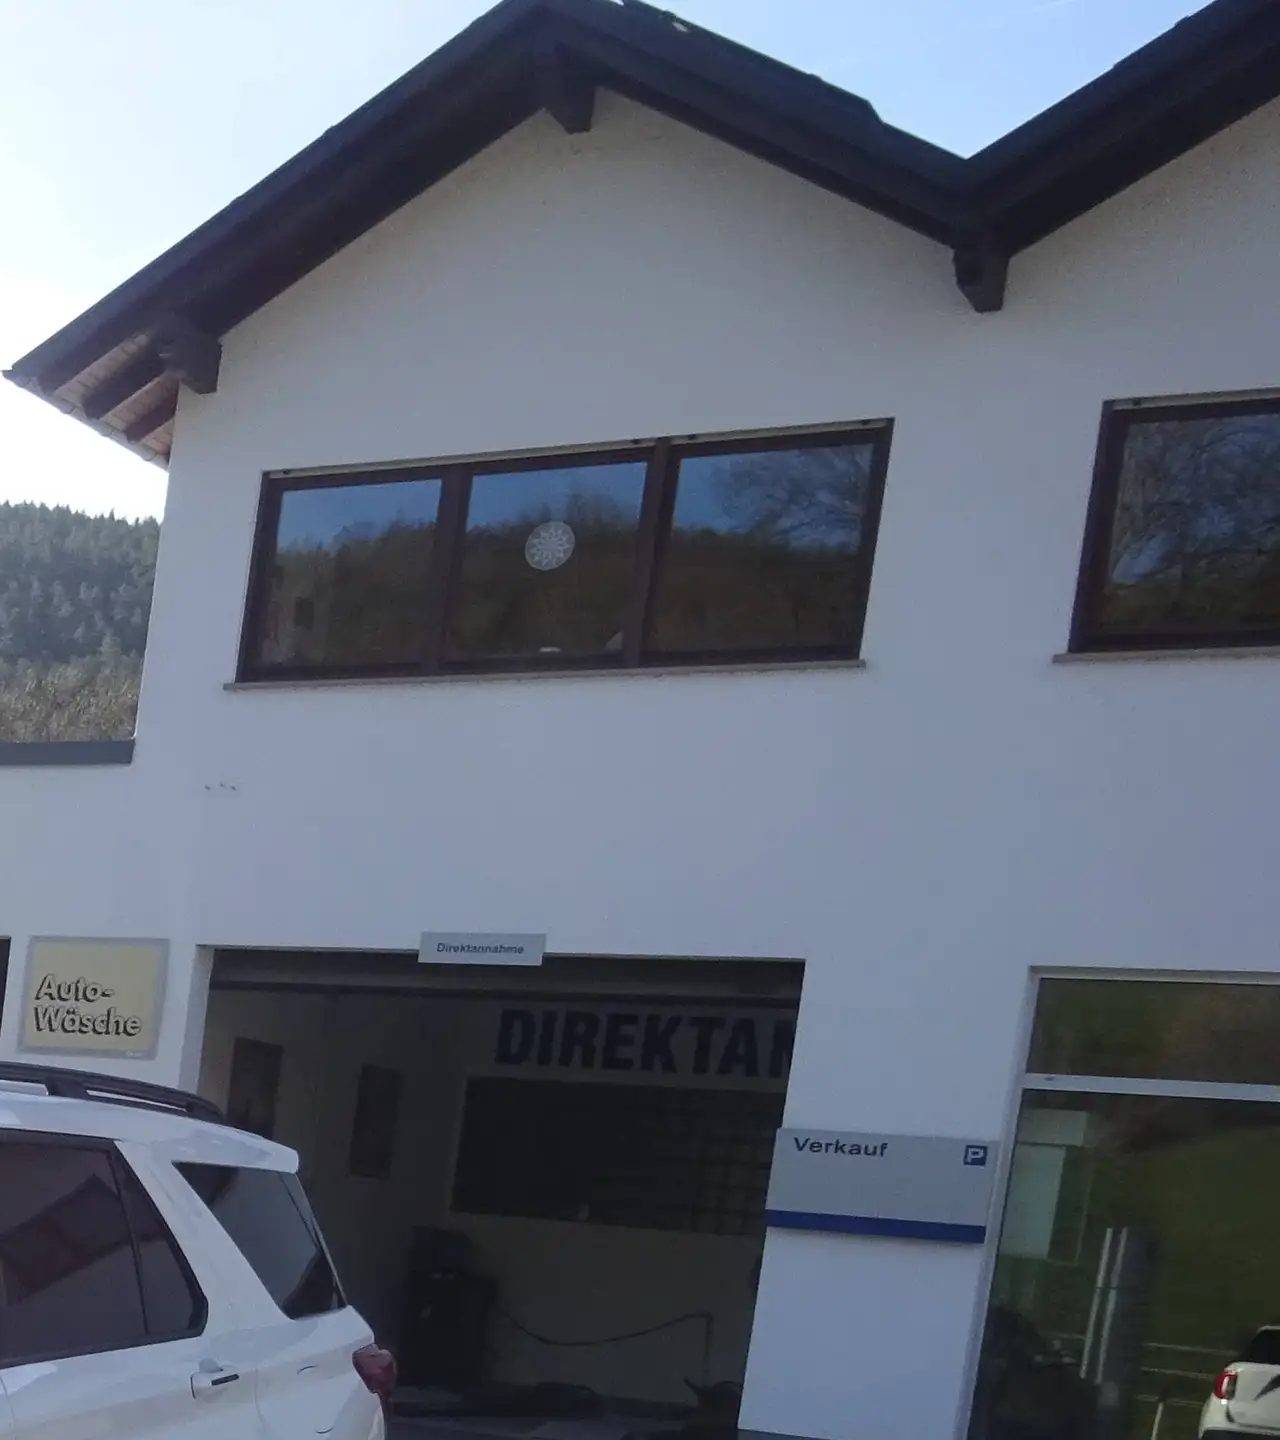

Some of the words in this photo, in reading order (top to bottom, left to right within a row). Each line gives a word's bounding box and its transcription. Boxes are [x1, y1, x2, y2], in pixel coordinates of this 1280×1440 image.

[436, 942, 525, 955] Direktannahme
[34, 973, 116, 1003] Auto-
[34, 1004, 143, 1037] Wäsche
[793, 1137, 889, 1158] Verkauf
[965, 1146, 986, 1165] P
